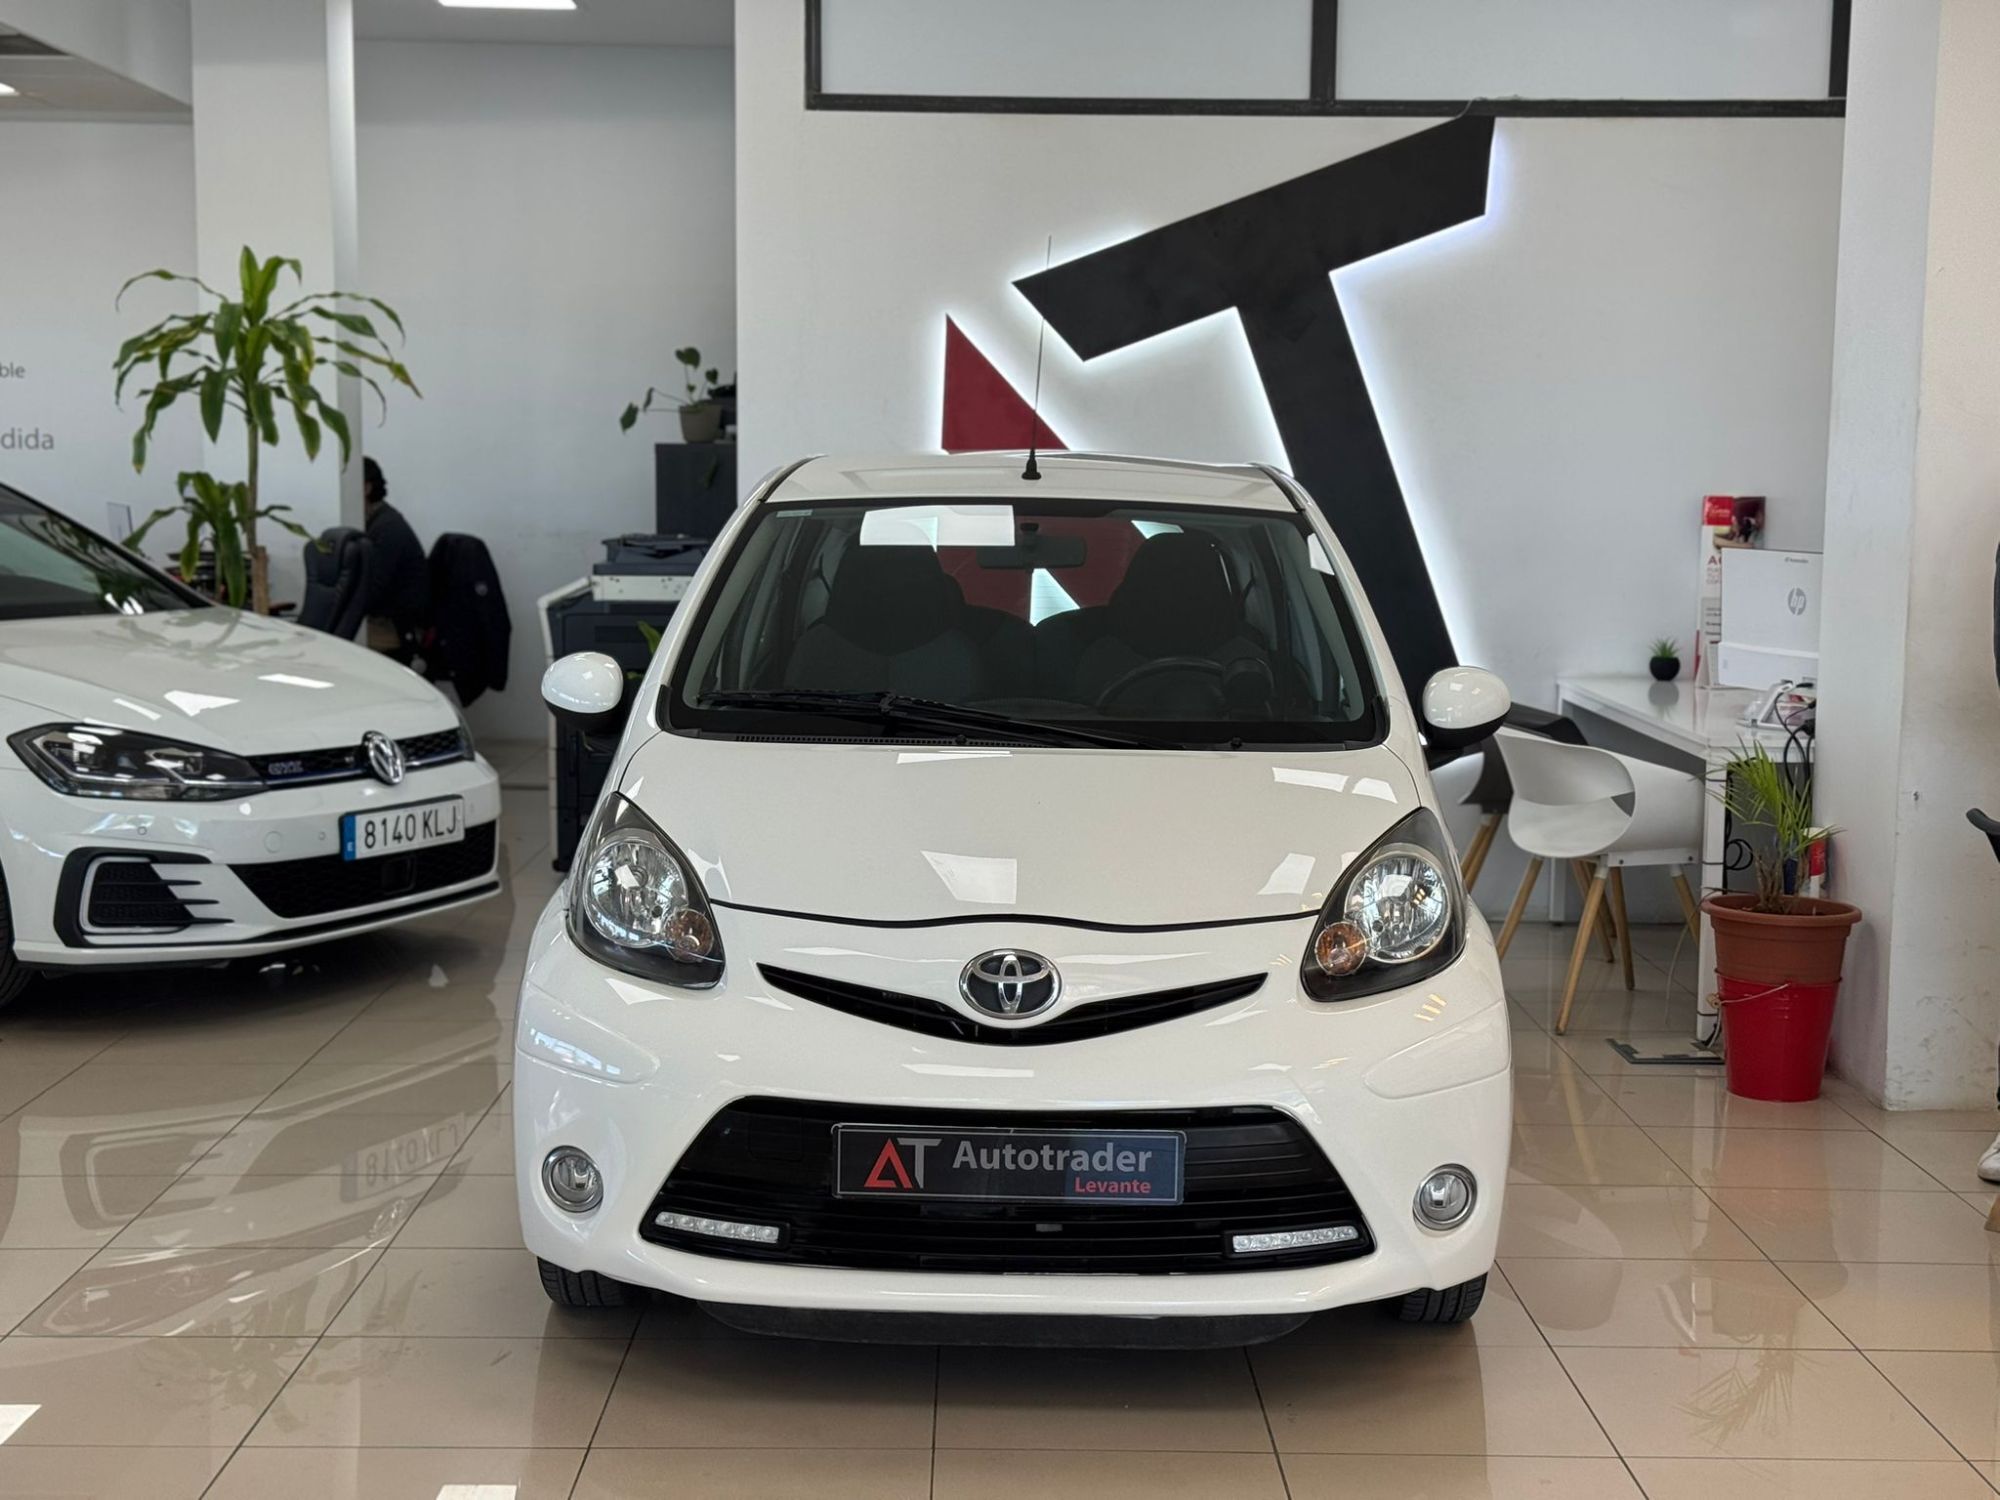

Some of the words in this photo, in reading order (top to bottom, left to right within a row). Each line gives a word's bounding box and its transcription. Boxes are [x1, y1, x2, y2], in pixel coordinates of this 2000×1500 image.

[0, 427, 55, 450] dida
[1788, 587, 1806, 615] hp
[364, 813, 416, 849] 8140
[423, 805, 456, 839] KLJ
[864, 1138, 942, 1189] AT
[952, 1140, 1152, 1173] Autotrader
[1075, 1177, 1151, 1194] Levante
